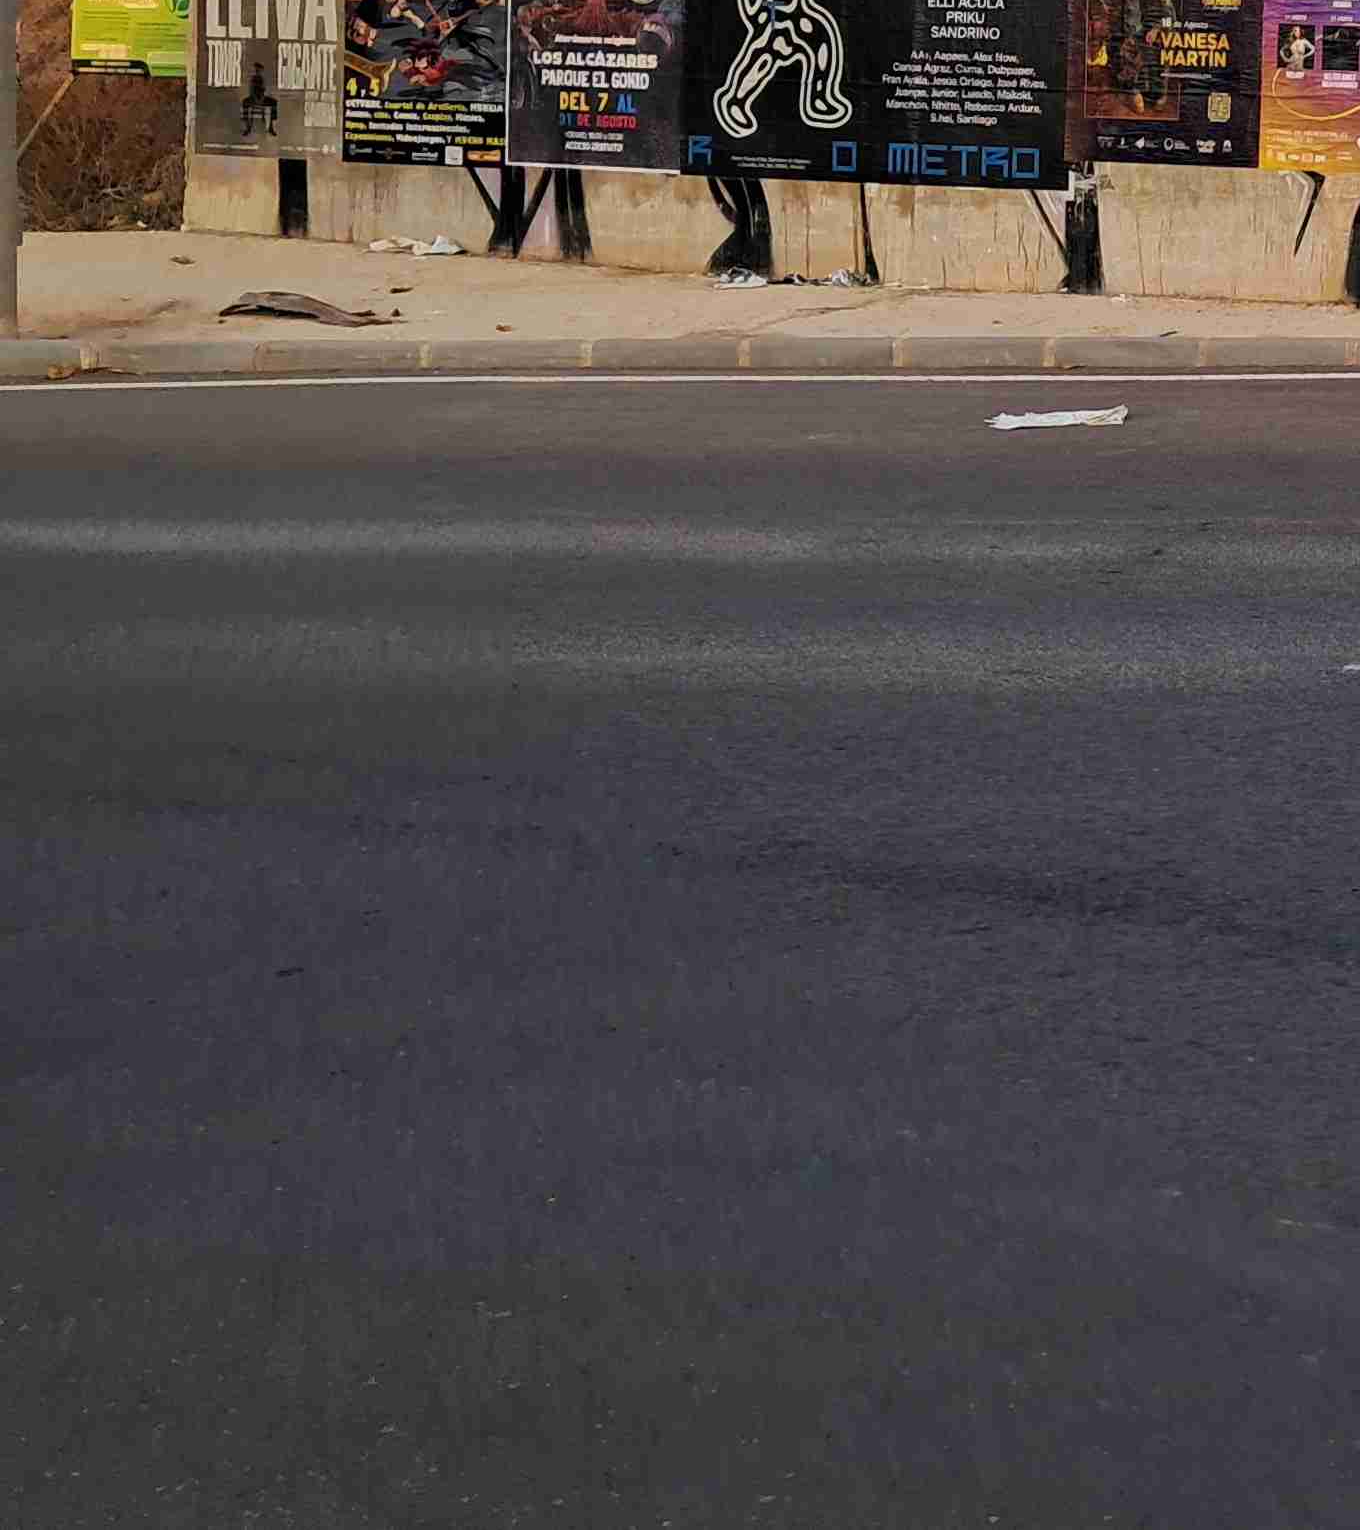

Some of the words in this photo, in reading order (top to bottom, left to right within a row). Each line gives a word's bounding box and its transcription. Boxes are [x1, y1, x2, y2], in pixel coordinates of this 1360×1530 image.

[945, 10, 986, 24] PRIKU
[930, 25, 1001, 40] SANDRINO
[1160, 31, 1231, 51] VANESA
[532, 50, 563, 65] LOS
[564, 49, 659, 69] ALCÁZARES
[1160, 49, 1228, 68] MARTÍN
[346, 77, 358, 97] 4
[370, 77, 380, 97] 5
[541, 69, 590, 87] PARQUE
[592, 71, 610, 88] EL
[560, 91, 590, 111] DEL
[597, 92, 609, 112] 7
[616, 93, 637, 113] AL
[956, 113, 998, 126] Santiago
[887, 140, 1041, 180] METRO
